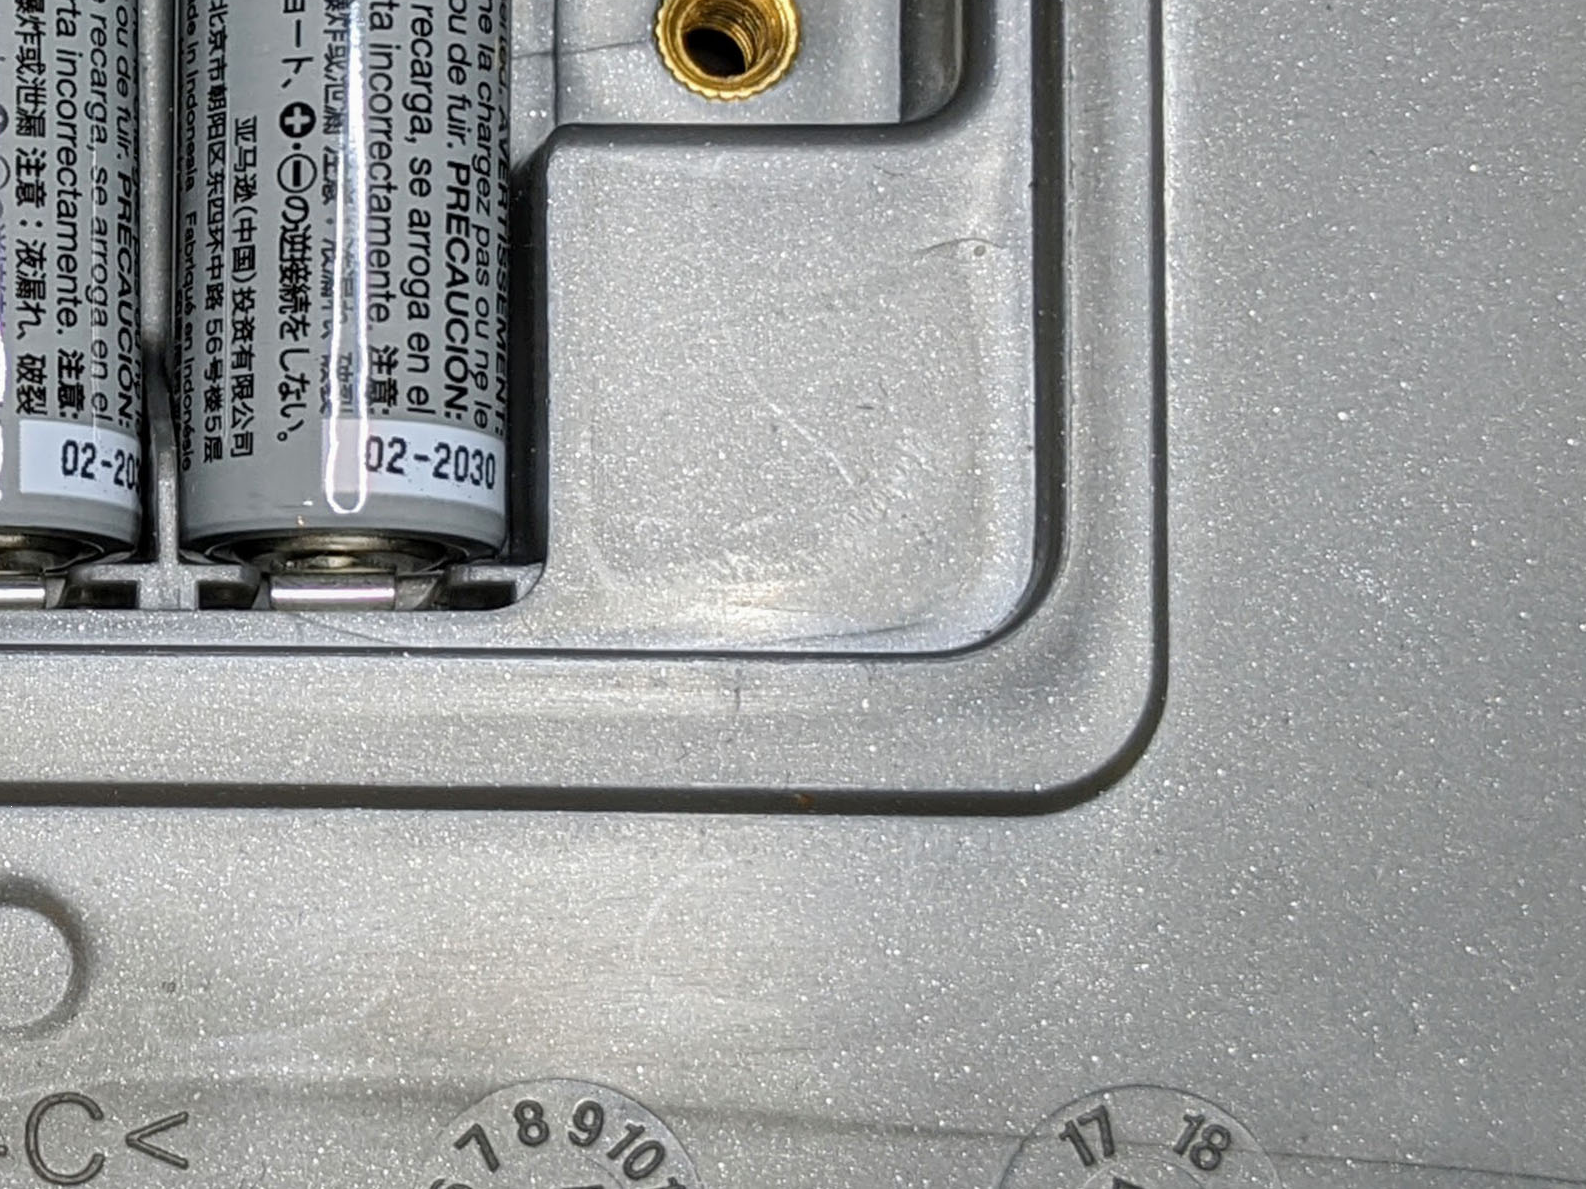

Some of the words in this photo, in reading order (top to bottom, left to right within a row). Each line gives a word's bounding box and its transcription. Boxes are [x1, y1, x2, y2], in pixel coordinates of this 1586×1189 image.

[401, 3, 434, 144] recarga,
[446, 42, 473, 87] de
[446, 93, 473, 149] fuir.
[55, 48, 84, 336] incorrectamente.
[366, 42, 402, 331] incorrectamente.
[408, 156, 433, 198] se
[398, 207, 432, 321] arroga
[443, 160, 478, 422] PRECAUCIÓN:
[406, 331, 431, 374] en
[405, 385, 437, 416] el
[363, 435, 497, 491] 02-2030
[453, 1122, 501, 1173] 7
[512, 1099, 551, 1148] 8
[567, 1100, 606, 1148] 9
[606, 1123, 667, 1181] 10
[1059, 1104, 1116, 1168] 17
[1172, 1113, 1232, 1171] 18
